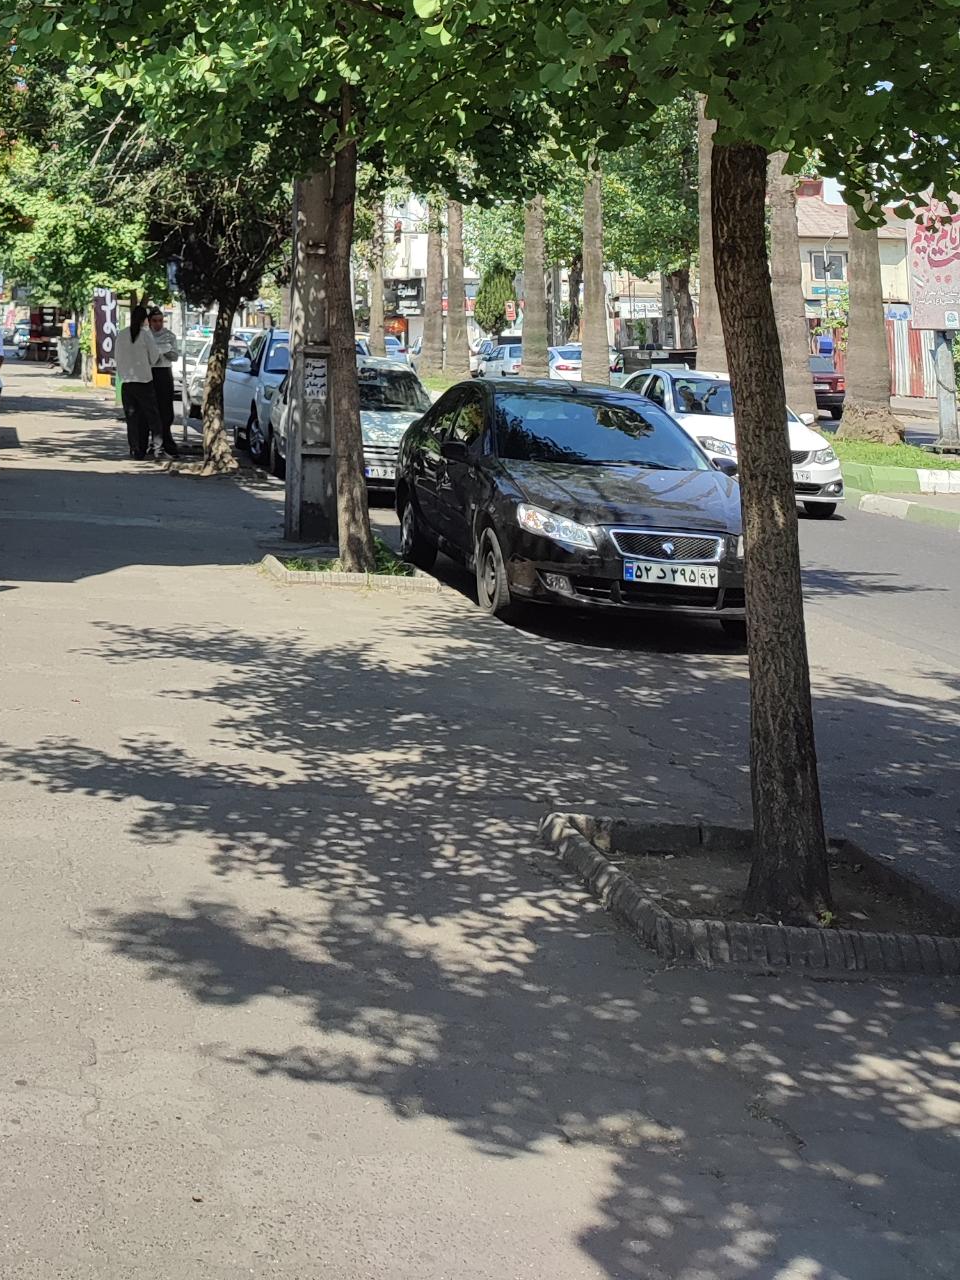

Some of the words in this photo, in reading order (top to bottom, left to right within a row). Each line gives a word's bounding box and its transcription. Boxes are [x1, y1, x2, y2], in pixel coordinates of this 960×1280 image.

[635, 565, 652, 579] ۵۲
[671, 567, 697, 583] ۳۹۵
[700, 572, 716, 585] ۹۲
